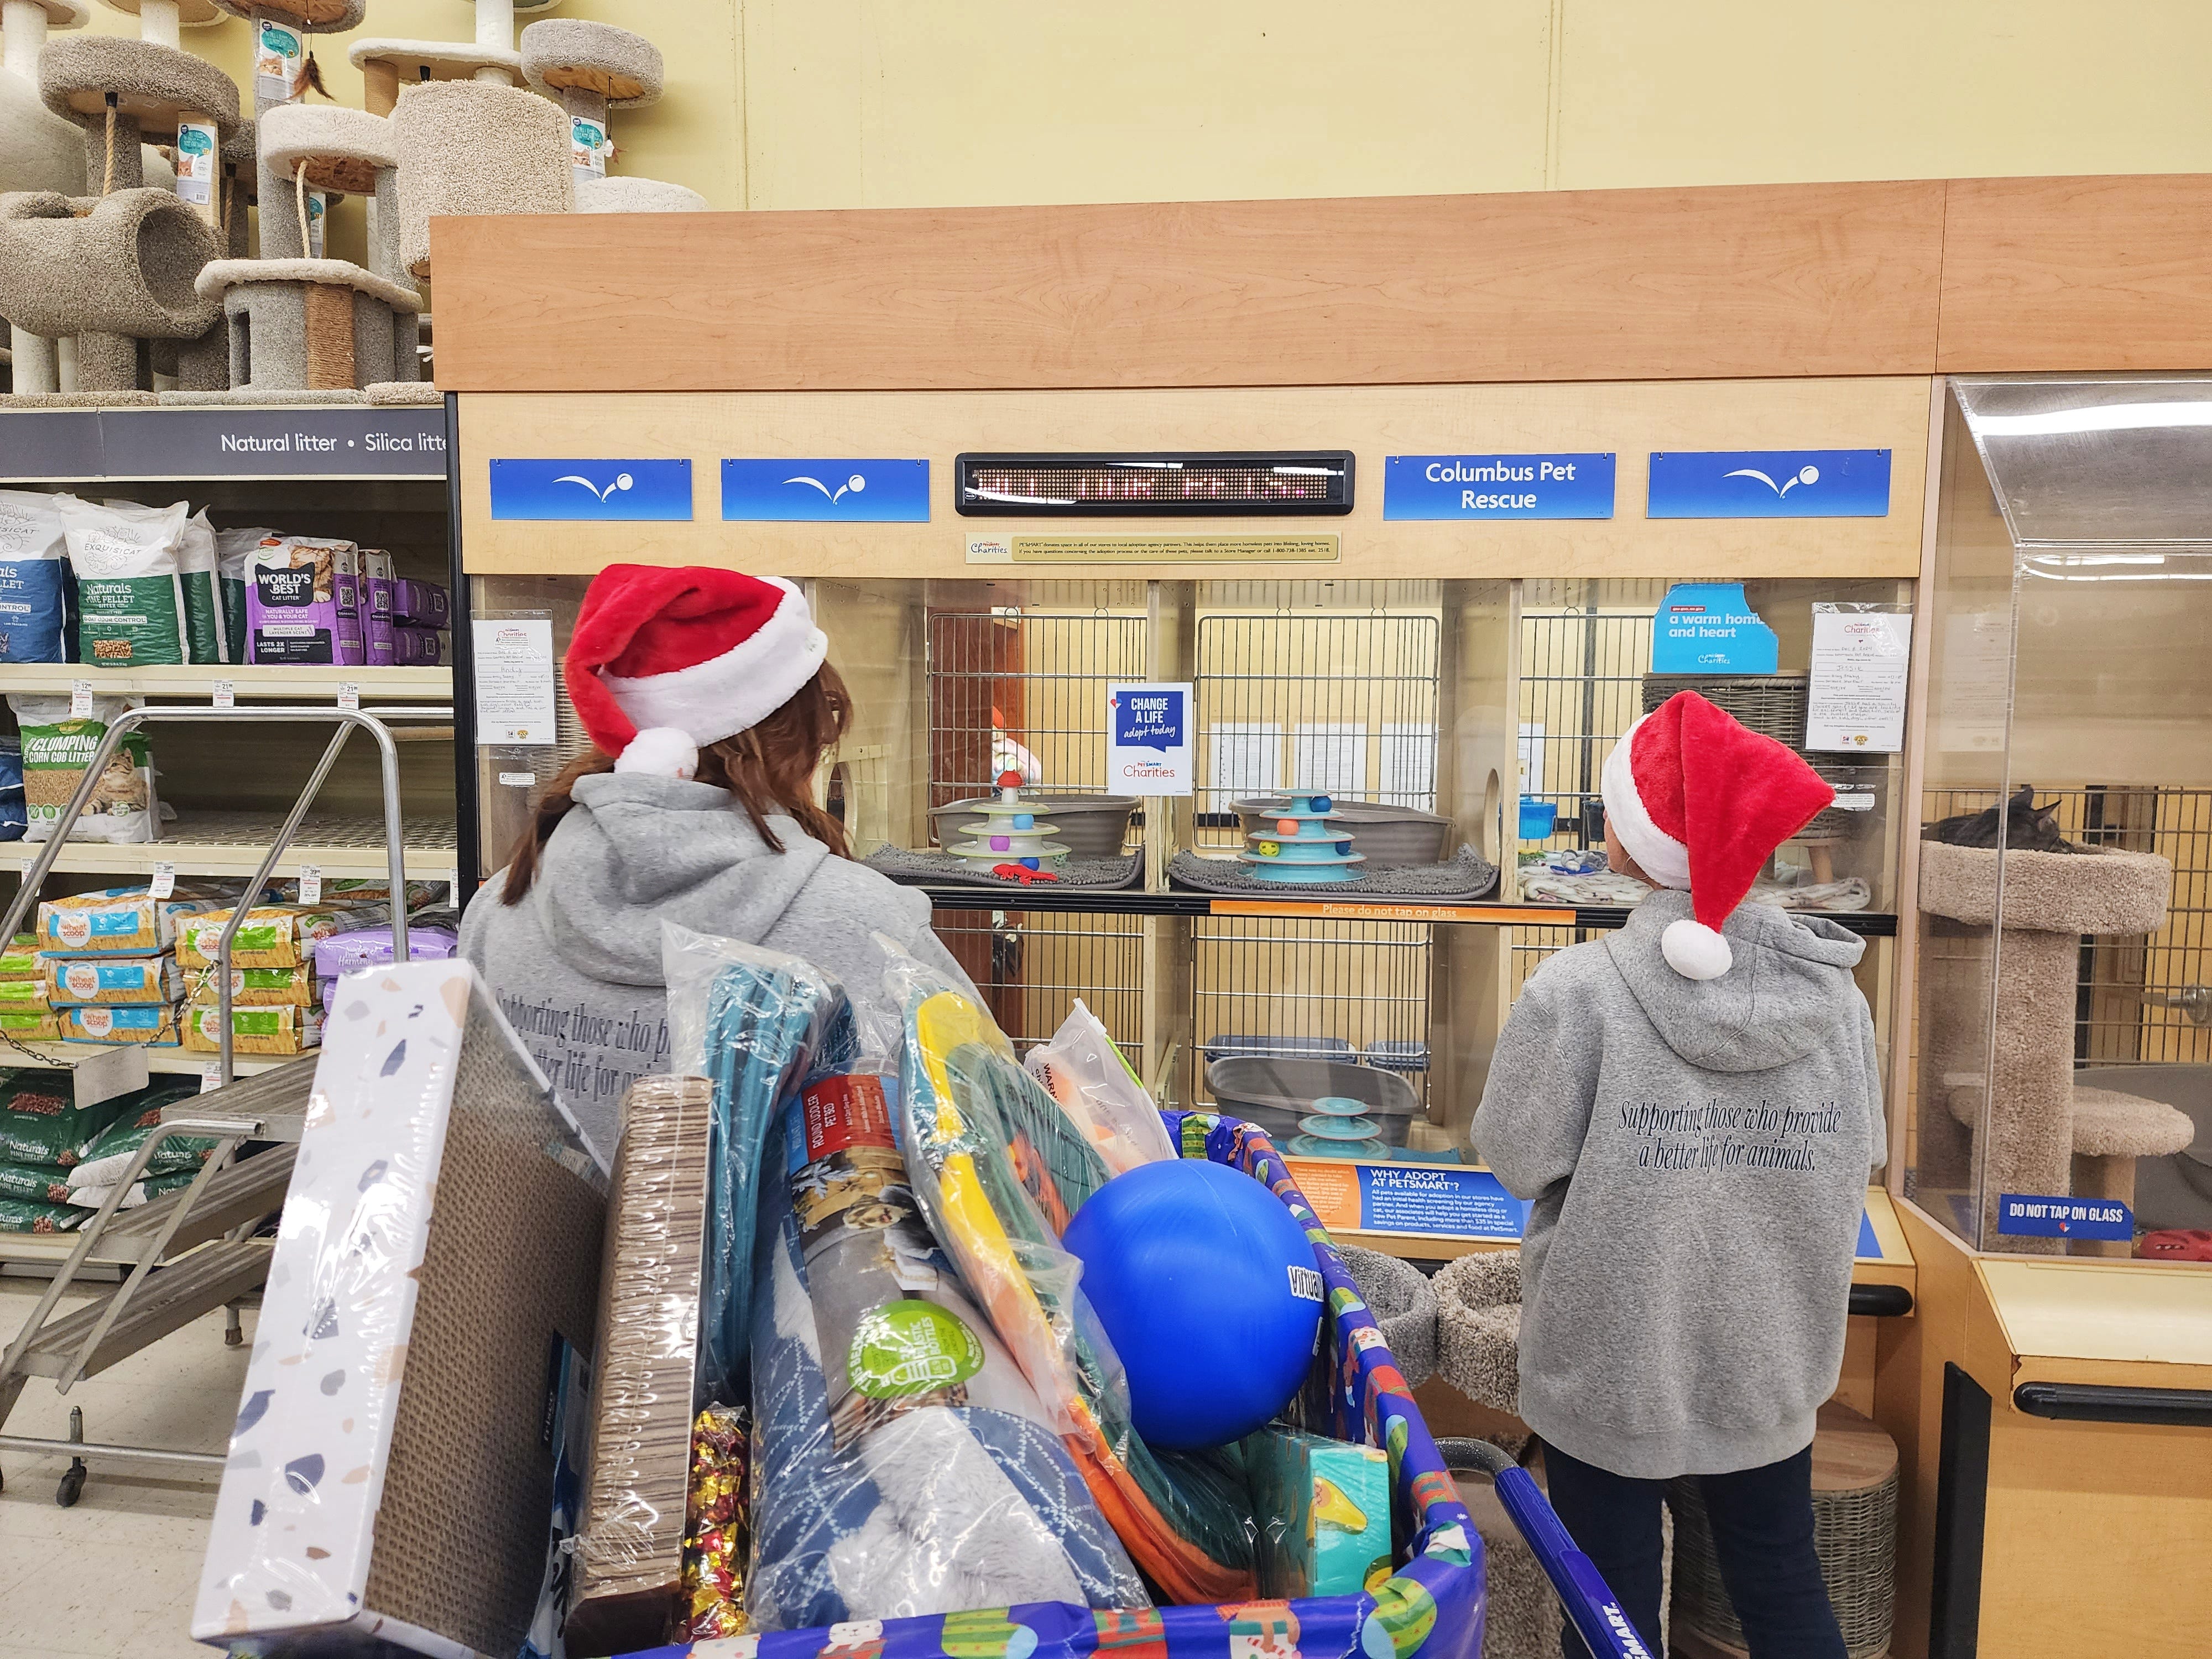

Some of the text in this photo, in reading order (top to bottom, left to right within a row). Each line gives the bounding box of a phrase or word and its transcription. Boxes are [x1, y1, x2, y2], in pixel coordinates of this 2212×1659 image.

[221, 433, 290, 451] Natural
[295, 433, 337, 451] litter
[366, 432, 413, 451] Silica
[1426, 461, 1577, 483] Columbus Pet
[1462, 490, 1537, 509] Rescue
[85, 543, 142, 555] EXQUISICAT
[971, 542, 1008, 553] Charities
[258, 573, 311, 585] WORLD'S
[86, 583, 132, 595] Naturals
[270, 584, 301, 594] BEST
[102, 595, 135, 603] PELLET
[1670, 615, 1678, 624] a
[1683, 615, 1721, 624] warm
[1668, 627, 1736, 638] and heart
[1131, 698, 1168, 710] CHANGE
[1135, 711, 1164, 723] A LIFE
[1124, 723, 1176, 741] adopt today
[32, 734, 98, 752] CLUMPING
[29, 752, 49, 763] CORN
[51, 752, 67, 763] COB
[1123, 765, 1175, 778] Charities
[1323, 904, 1355, 915] Please
[1358, 905, 1372, 916] do
[1374, 906, 1392, 916] not
[1395, 907, 1412, 920] tap
[1432, 907, 1457, 919] glass
[571, 1003, 613, 1047] those
[615, 1010, 651, 1052] who
[564, 1050, 591, 1099] life
[823, 1103, 837, 1128] PET BED
[1618, 1098, 1842, 1139] Supporting those who provide
[811, 1123, 826, 1149] ROUND
[10, 1140, 50, 1155] Naturals
[1639, 1134, 1816, 1173] a better life for animals.
[0, 1172, 38, 1188] Naturals
[1370, 1169, 1446, 1181] WHY ADOPT
[1371, 1178, 1386, 1187] AT
[2009, 1203, 2124, 1223] DO NOT TAP ON GLASS
[921, 1316, 941, 1355] BOTTLES
